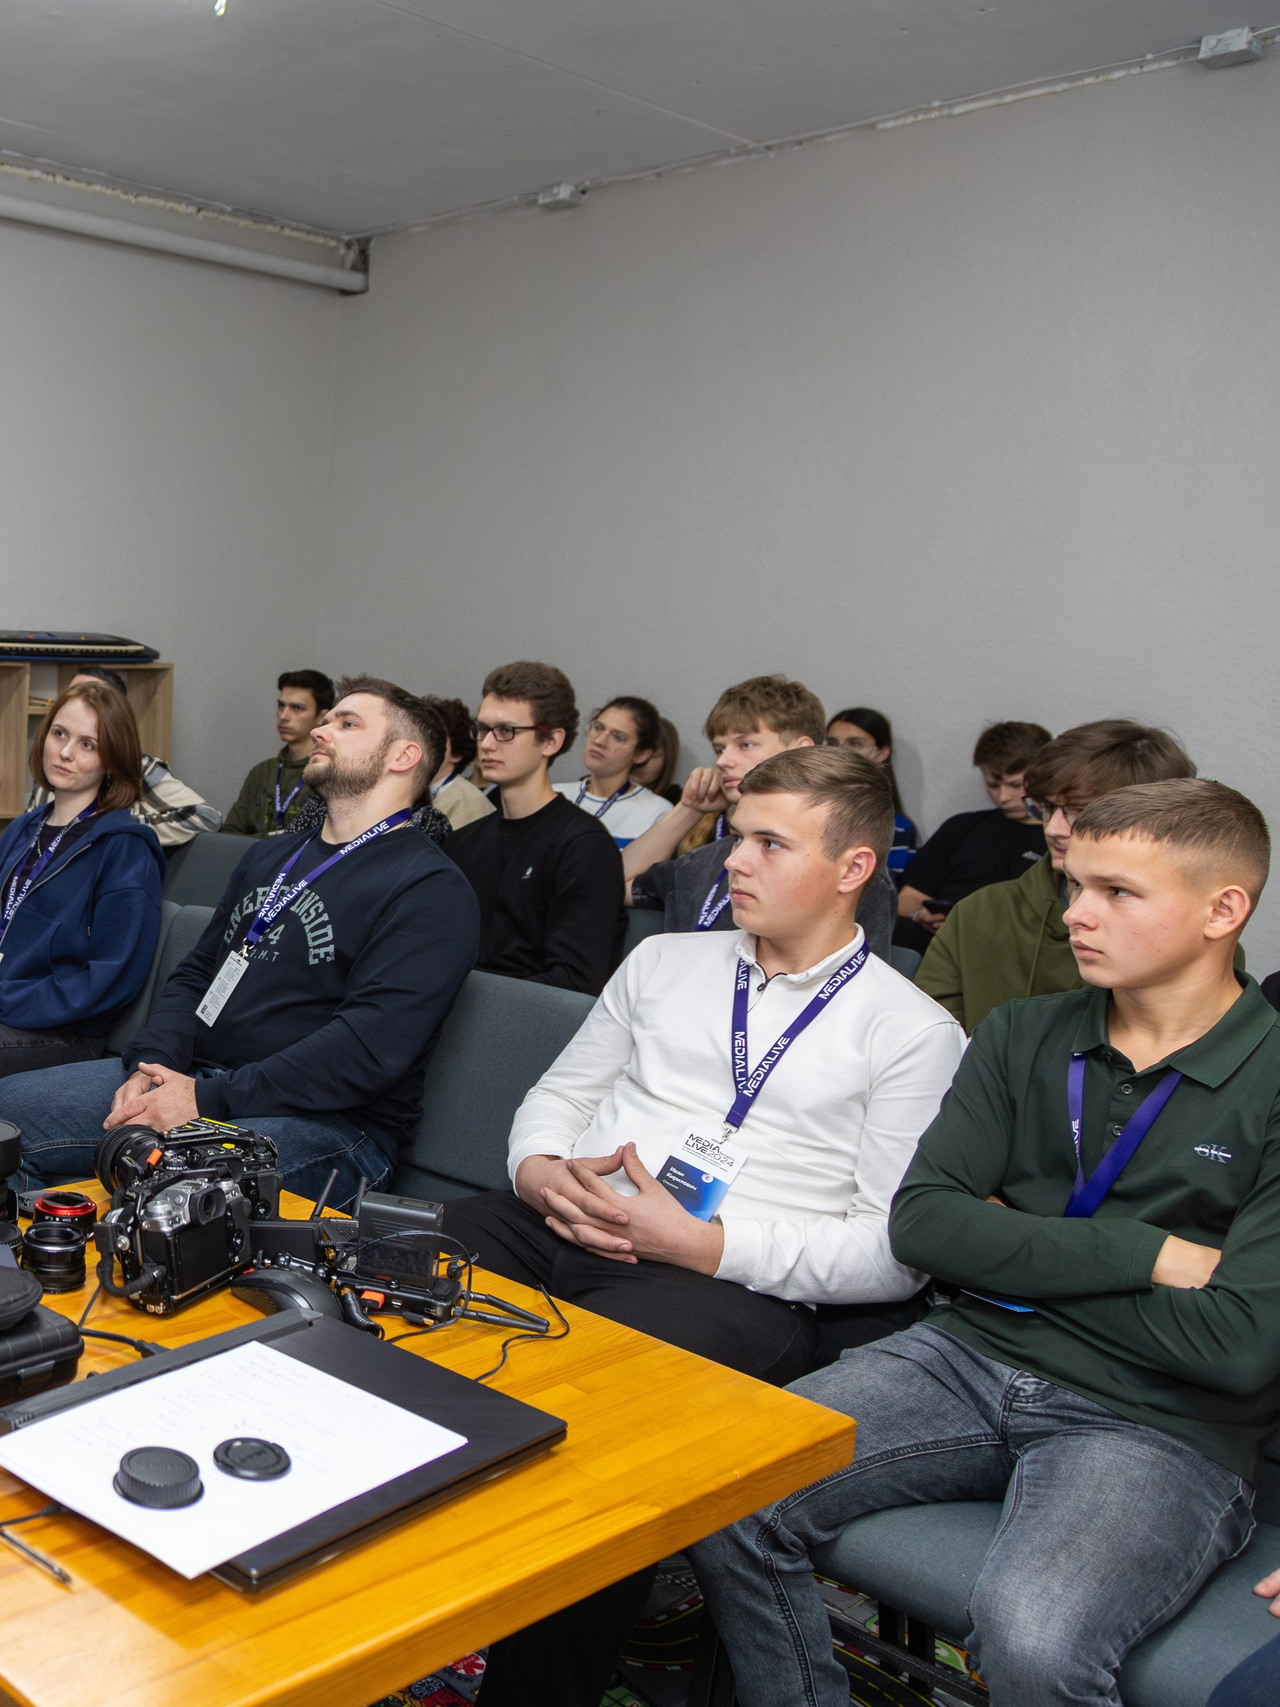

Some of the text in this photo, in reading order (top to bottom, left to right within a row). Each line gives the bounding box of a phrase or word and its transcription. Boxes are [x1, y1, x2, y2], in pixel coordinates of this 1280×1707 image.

[340, 820, 389, 855] MEDIALIVE
[258, 872, 287, 919] MEDIALIVE
[263, 879, 308, 924] MEDIALIVE
[818, 950, 867, 1000] MEDIALIVE
[734, 1031, 748, 1094] MEDIALIV
[742, 1036, 791, 1098] MEDIALIVE
[688, 1133, 721, 1154] MEDIA
[669, 1166, 685, 1177] Иван
